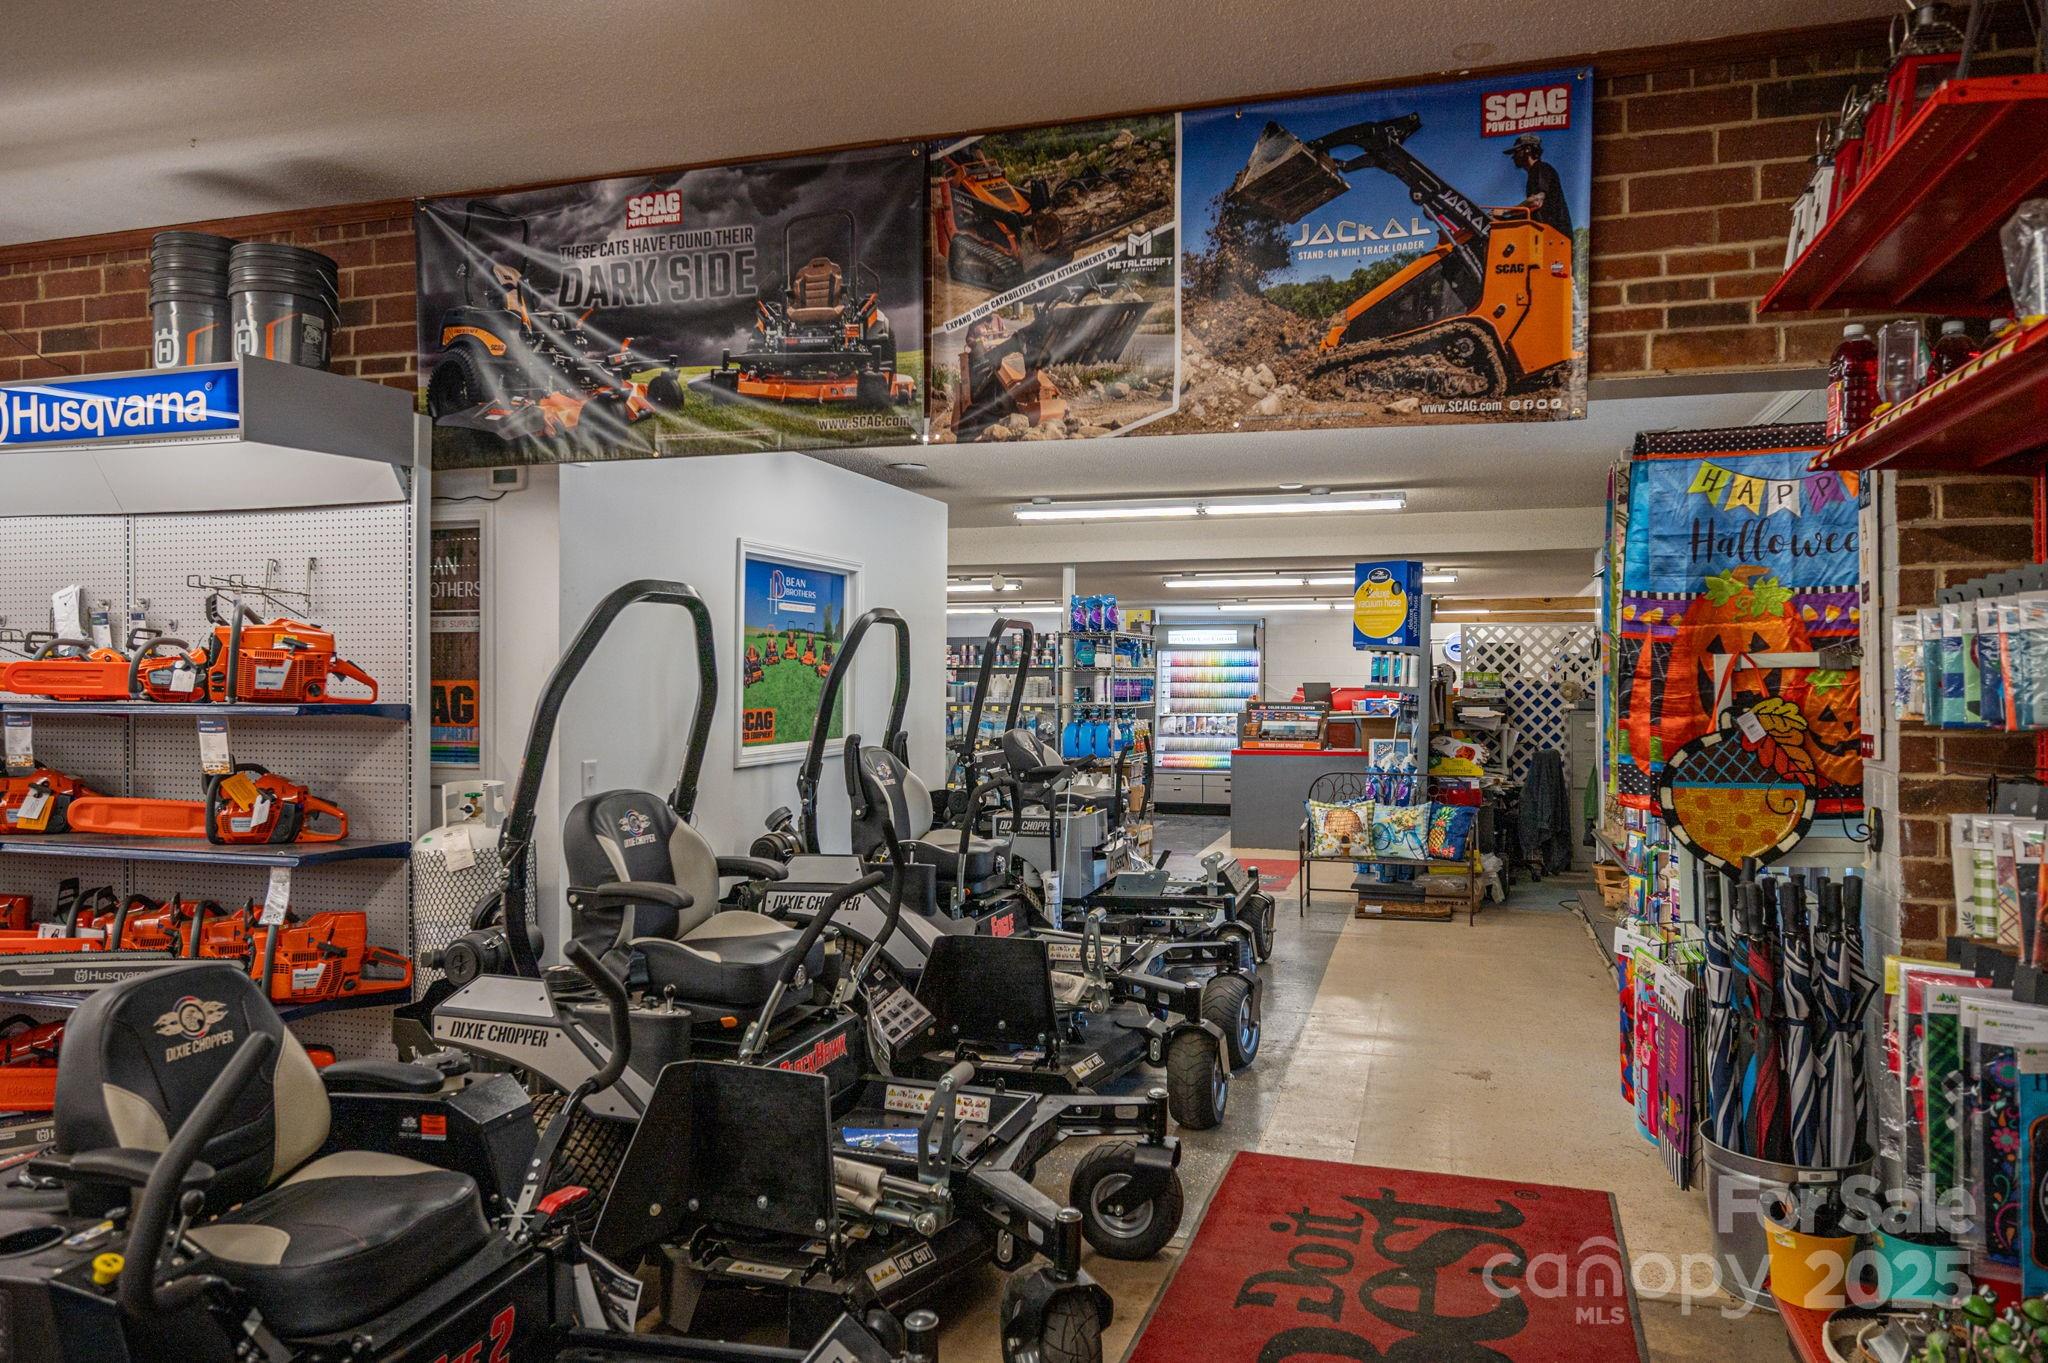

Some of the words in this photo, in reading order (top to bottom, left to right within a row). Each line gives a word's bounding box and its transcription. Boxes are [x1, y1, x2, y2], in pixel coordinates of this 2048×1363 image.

[1486, 88, 1567, 121] SCAG
[1486, 120, 1516, 133] POWER
[1518, 114, 1567, 129] EQUIPMENT
[628, 192, 681, 219] SCAG
[628, 217, 647, 228] POWER
[648, 213, 681, 225] EQUIPMENT
[1291, 217, 1431, 247] JACKAL
[560, 243, 597, 260] THESE
[600, 240, 629, 257] CATS
[633, 235, 666, 253] HAVE
[669, 231, 712, 249] FOUND
[715, 227, 754, 245] THEIR
[1298, 248, 1340, 261] STAND-ON
[1341, 246, 1360, 258] MINI
[1362, 243, 1390, 256] TRACK
[1392, 240, 1425, 253] LOADER
[1107, 256, 1173, 270] METALCRAFT
[1495, 264, 1525, 274] SCAG
[558, 258, 660, 308] DARK
[669, 249, 758, 300] SIDE
[945, 313, 972, 331] EXPAND
[972, 303, 990, 318] YOUR
[990, 281, 1037, 310] CAPABILITIES
[1038, 273, 1056, 289] WITH
[1057, 252, 1107, 279] ATTACHMENTS
[1107, 246, 1118, 259] BY
[14, 389, 207, 436] Husqvarna
[1421, 400, 1502, 414] www.SCAG.com
[818, 415, 910, 430] www.SCAG.com
[1701, 468, 1833, 505] HAPP
[1690, 517, 1859, 564] Hallowee
[432, 556, 458, 576] AN
[430, 581, 480, 598] OTHERS
[786, 576, 806, 588] BEAN
[786, 588, 816, 599] BROTHERS
[1357, 600, 1382, 608] vacuum
[1384, 598, 1401, 607] hose
[431, 685, 474, 724] AG
[773, 895, 806, 910] DIXIE
[806, 895, 862, 911] CHER
[88, 970, 147, 981] Husqvarn
[450, 1020, 487, 1040] DIXIE
[487, 1025, 549, 1048] CHOPPER
[166, 1042, 192, 1062] DIXIE
[192, 1029, 234, 1053] CHOPPER
[913, 1247, 932, 1264] CUT
[1257, 1187, 1530, 1363] est
